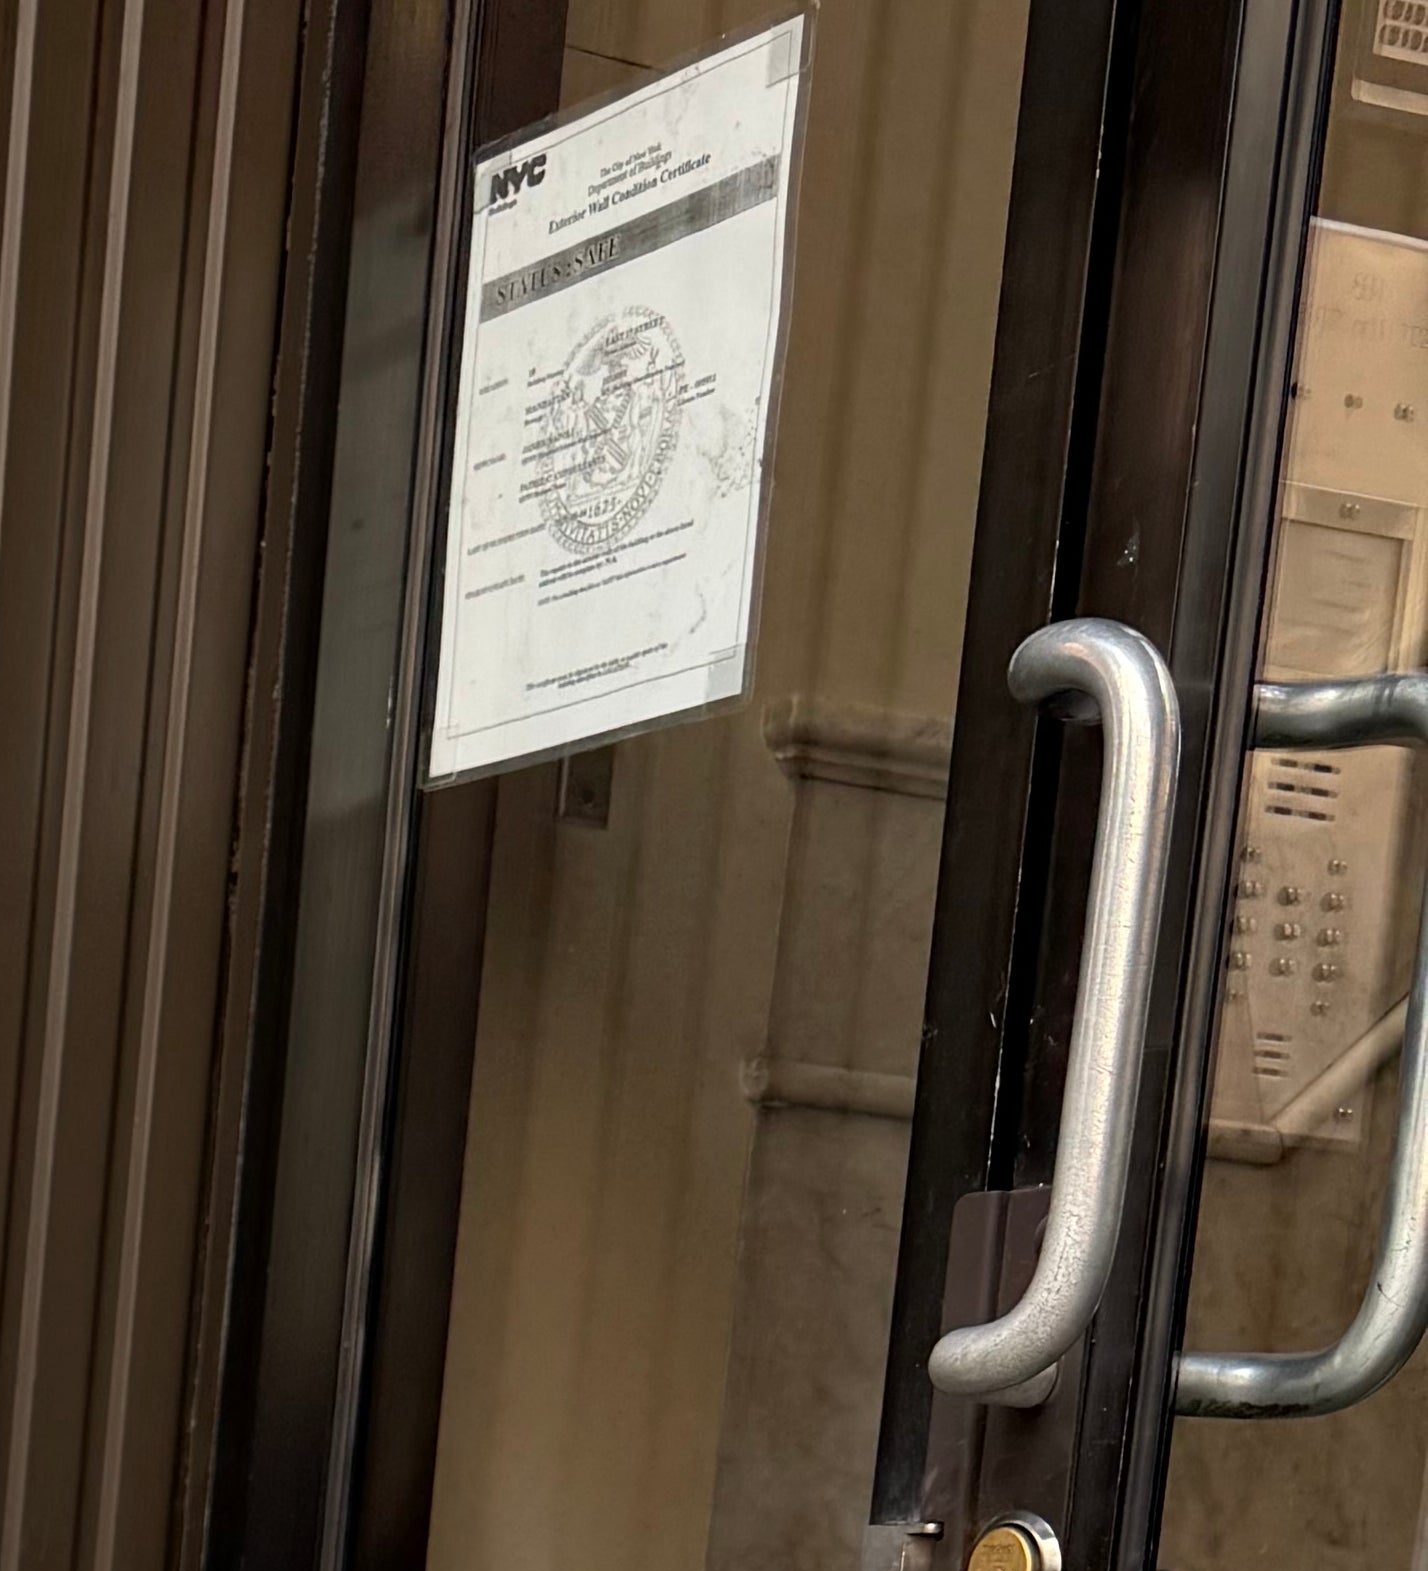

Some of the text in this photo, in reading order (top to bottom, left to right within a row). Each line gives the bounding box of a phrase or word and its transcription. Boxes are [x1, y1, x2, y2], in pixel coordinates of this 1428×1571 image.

[490, 153, 547, 204] NYC
[548, 153, 711, 234] Exterior Wall Condition Certificate
